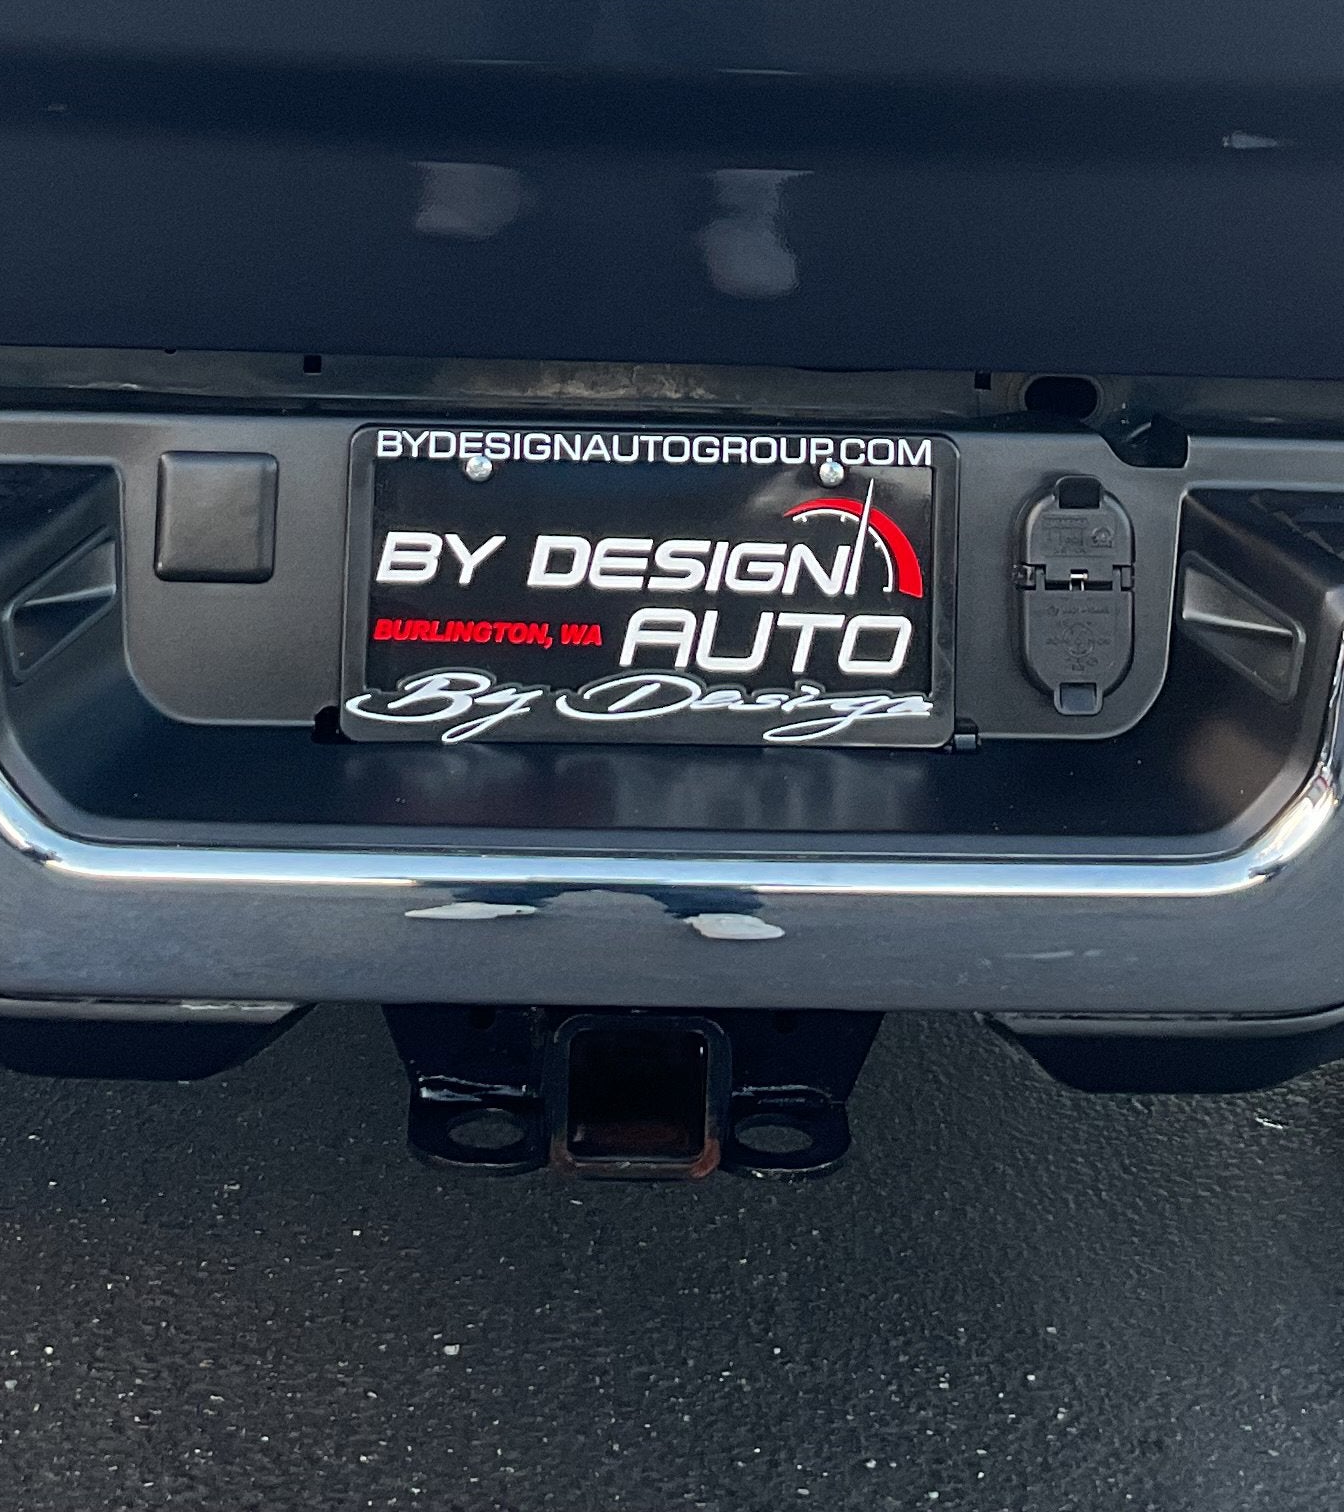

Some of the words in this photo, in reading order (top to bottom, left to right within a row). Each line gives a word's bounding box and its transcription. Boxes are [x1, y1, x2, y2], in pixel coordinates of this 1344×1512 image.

[377, 430, 932, 466] BYDESIGNAUTOGROUP.COM
[375, 531, 506, 585] BY
[527, 535, 851, 595] DESIGN
[373, 619, 553, 649] BURLINGTON,
[561, 624, 603, 646] WA
[619, 607, 912, 674] AUTO
[346, 672, 543, 744] By
[556, 674, 933, 741] Design
